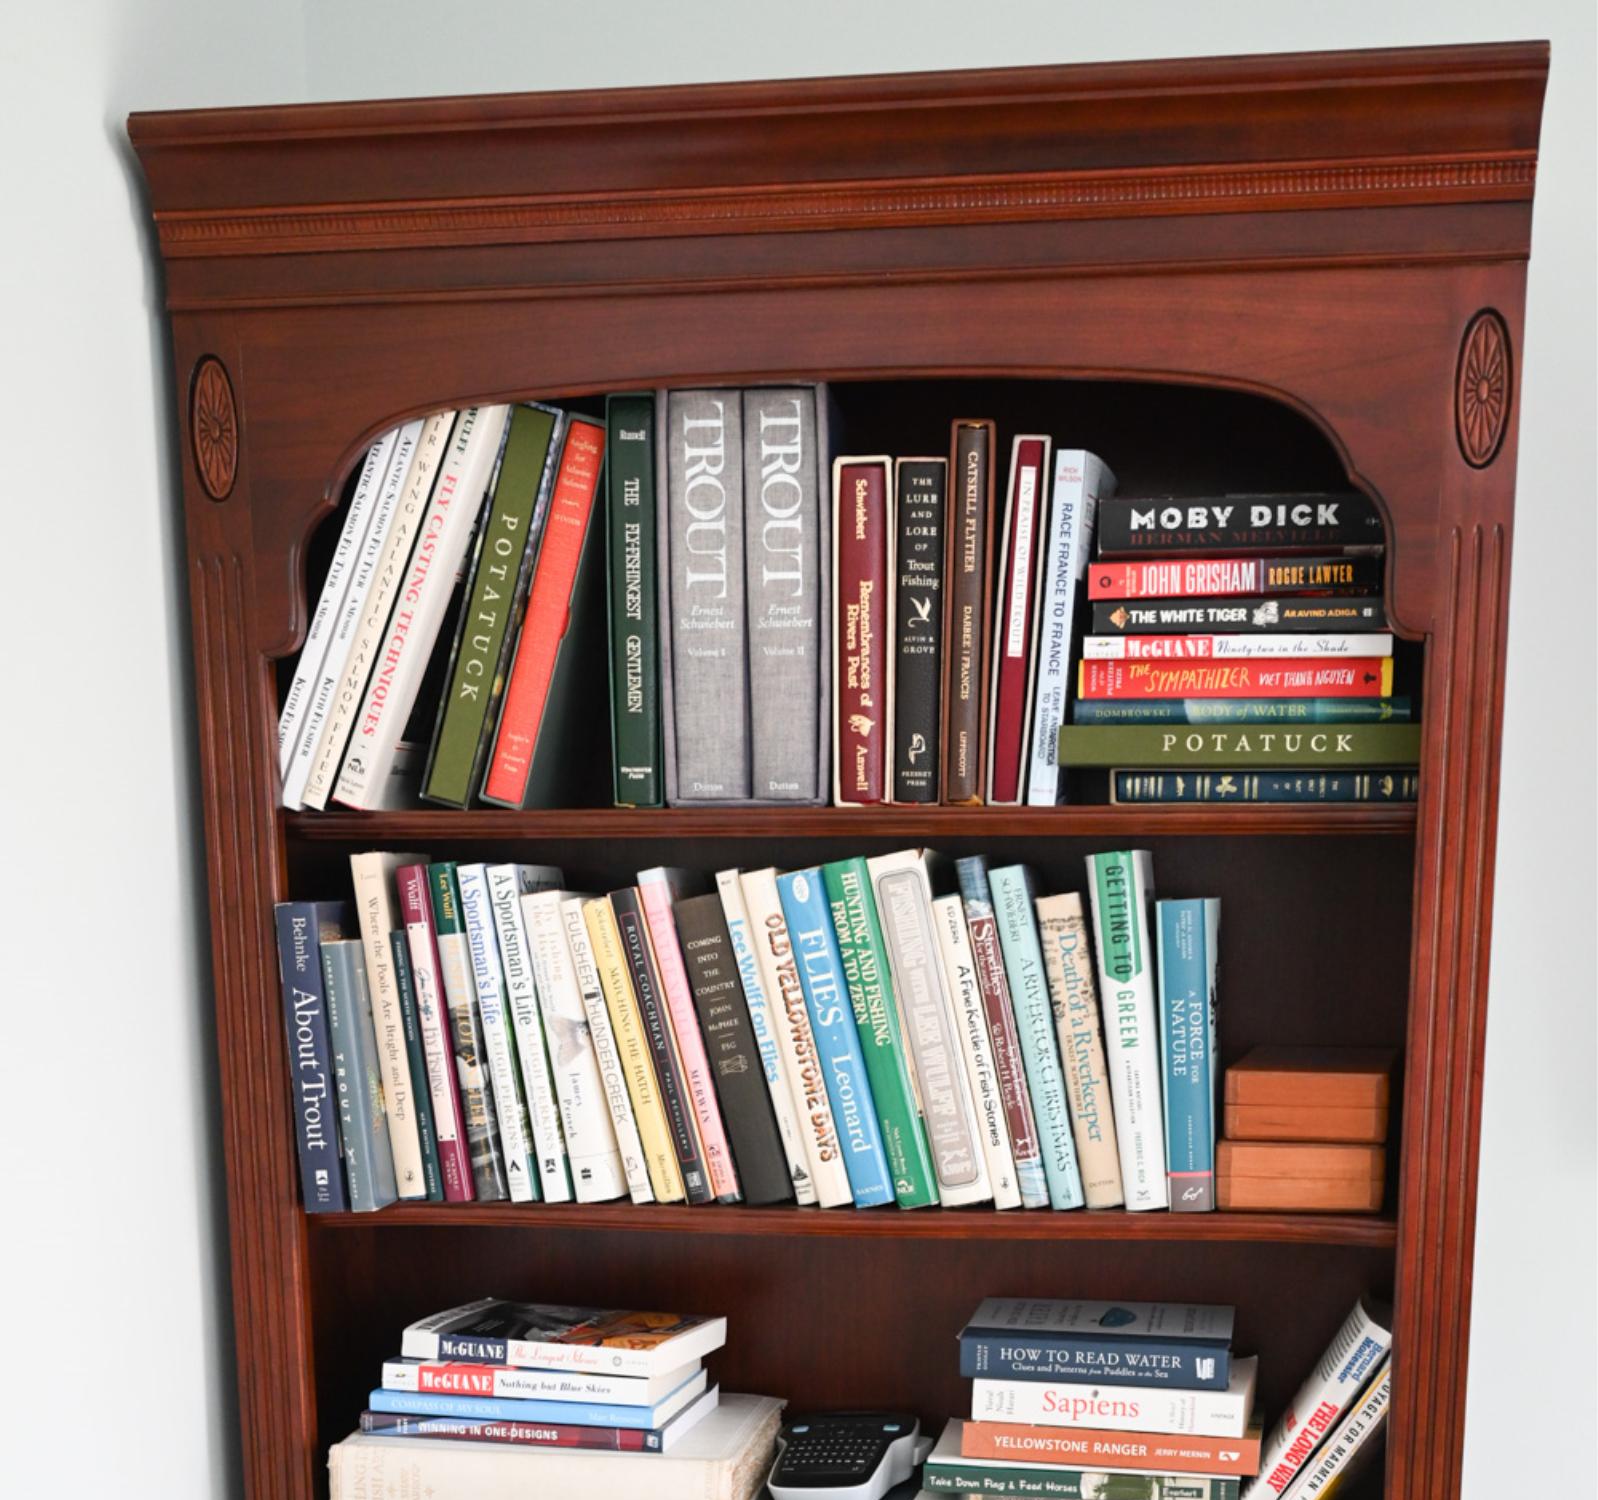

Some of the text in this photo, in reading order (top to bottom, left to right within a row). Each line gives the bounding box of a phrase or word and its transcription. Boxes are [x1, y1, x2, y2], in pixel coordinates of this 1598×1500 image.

[624, 477, 640, 507] THE
[966, 451, 979, 514] CATSKILL
[683, 401, 727, 599] TROUT
[759, 400, 804, 597] TROUT
[906, 494, 938, 504] LURE
[910, 510, 933, 519] AND
[1130, 504, 1339, 530] MOBY DICK
[906, 526, 938, 537] LORE
[1130, 531, 1222, 545] HERMAN
[906, 559, 936, 572] Trout
[1140, 562, 1255, 595] JOHN GRISHAM
[1268, 564, 1353, 586] ROGUE LAWYER
[901, 574, 940, 590] Fishing
[1047, 503, 1074, 676] RACE FRANCE TO FRANCE
[362, 472, 458, 737] FLY CASTING TECHNIQUES
[460, 513, 519, 701] POTATUCK
[1129, 608, 1247, 624] THE WHITE TIGER
[1283, 608, 1357, 619] ARAVIND ADIGA
[847, 604, 860, 689] Rivers Past
[903, 646, 935, 655] GROVE
[1127, 639, 1210, 658] McGUANE
[1129, 663, 1250, 693] THE SYMPATHIZER
[1254, 705, 1307, 717] WATER
[1162, 734, 1353, 752] POTATUCK
[292, 917, 310, 972] Behnke
[461, 873, 501, 1025] A Sportsman's Life
[493, 874, 536, 1025] A Sportsman's Life
[687, 935, 722, 950] COMING
[1105, 865, 1139, 1048] GETTING TO GREEN
[697, 953, 718, 964] INTO
[830, 901, 869, 1025] FROM A TO ZERN
[841, 872, 892, 1047] HUNTING AND FISHING
[972, 923, 1001, 995] Stoneflies
[703, 968, 720, 978] THE
[798, 928, 844, 1027] FLIES
[626, 925, 665, 1050] ROYAL COACHMAN
[695, 980, 735, 997] COUNTRY
[566, 911, 594, 986] FULSHER
[605, 1074, 629, 1125] CREEK
[709, 1004, 732, 1016] JOHN
[1171, 1000, 1186, 1077] NATURE
[1188, 990, 1204, 1084] A FORCE FOR
[292, 987, 328, 1150] About Trout
[336, 1053, 352, 1123] TROUT
[690, 1069, 710, 1123] MERWIN
[831, 1053, 872, 1153] Leonard
[441, 1336, 505, 1359] McGUANE
[1000, 1347, 1182, 1368] HOW TO READ WATER
[1012, 1363, 1035, 1371] Clues
[1037, 1364, 1052, 1372] and
[1054, 1365, 1087, 1374] Patterns
[1104, 1367, 1136, 1377] Puddles
[1155, 1369, 1168, 1378] Sea
[1353, 1343, 1383, 1382] Bernard
[422, 1372, 493, 1393] McGUANE
[499, 1378, 611, 1394] Nothing but Blue Skies
[1042, 1389, 1140, 1422] Sapiens
[418, 1423, 558, 1441] WINNING IN ONE-DESIGNS
[994, 1435, 1147, 1457] YELLOWSTONE RANGER
[1154, 1447, 1178, 1457] JERRY
[1266, 1401, 1339, 1493] THE LONG WAY
[929, 1476, 952, 1488] Take
[955, 1477, 980, 1488] Down
[1008, 1479, 1015, 1490] &
[1045, 1481, 1078, 1492] Horses
[1163, 1487, 1198, 1498] Everhart
